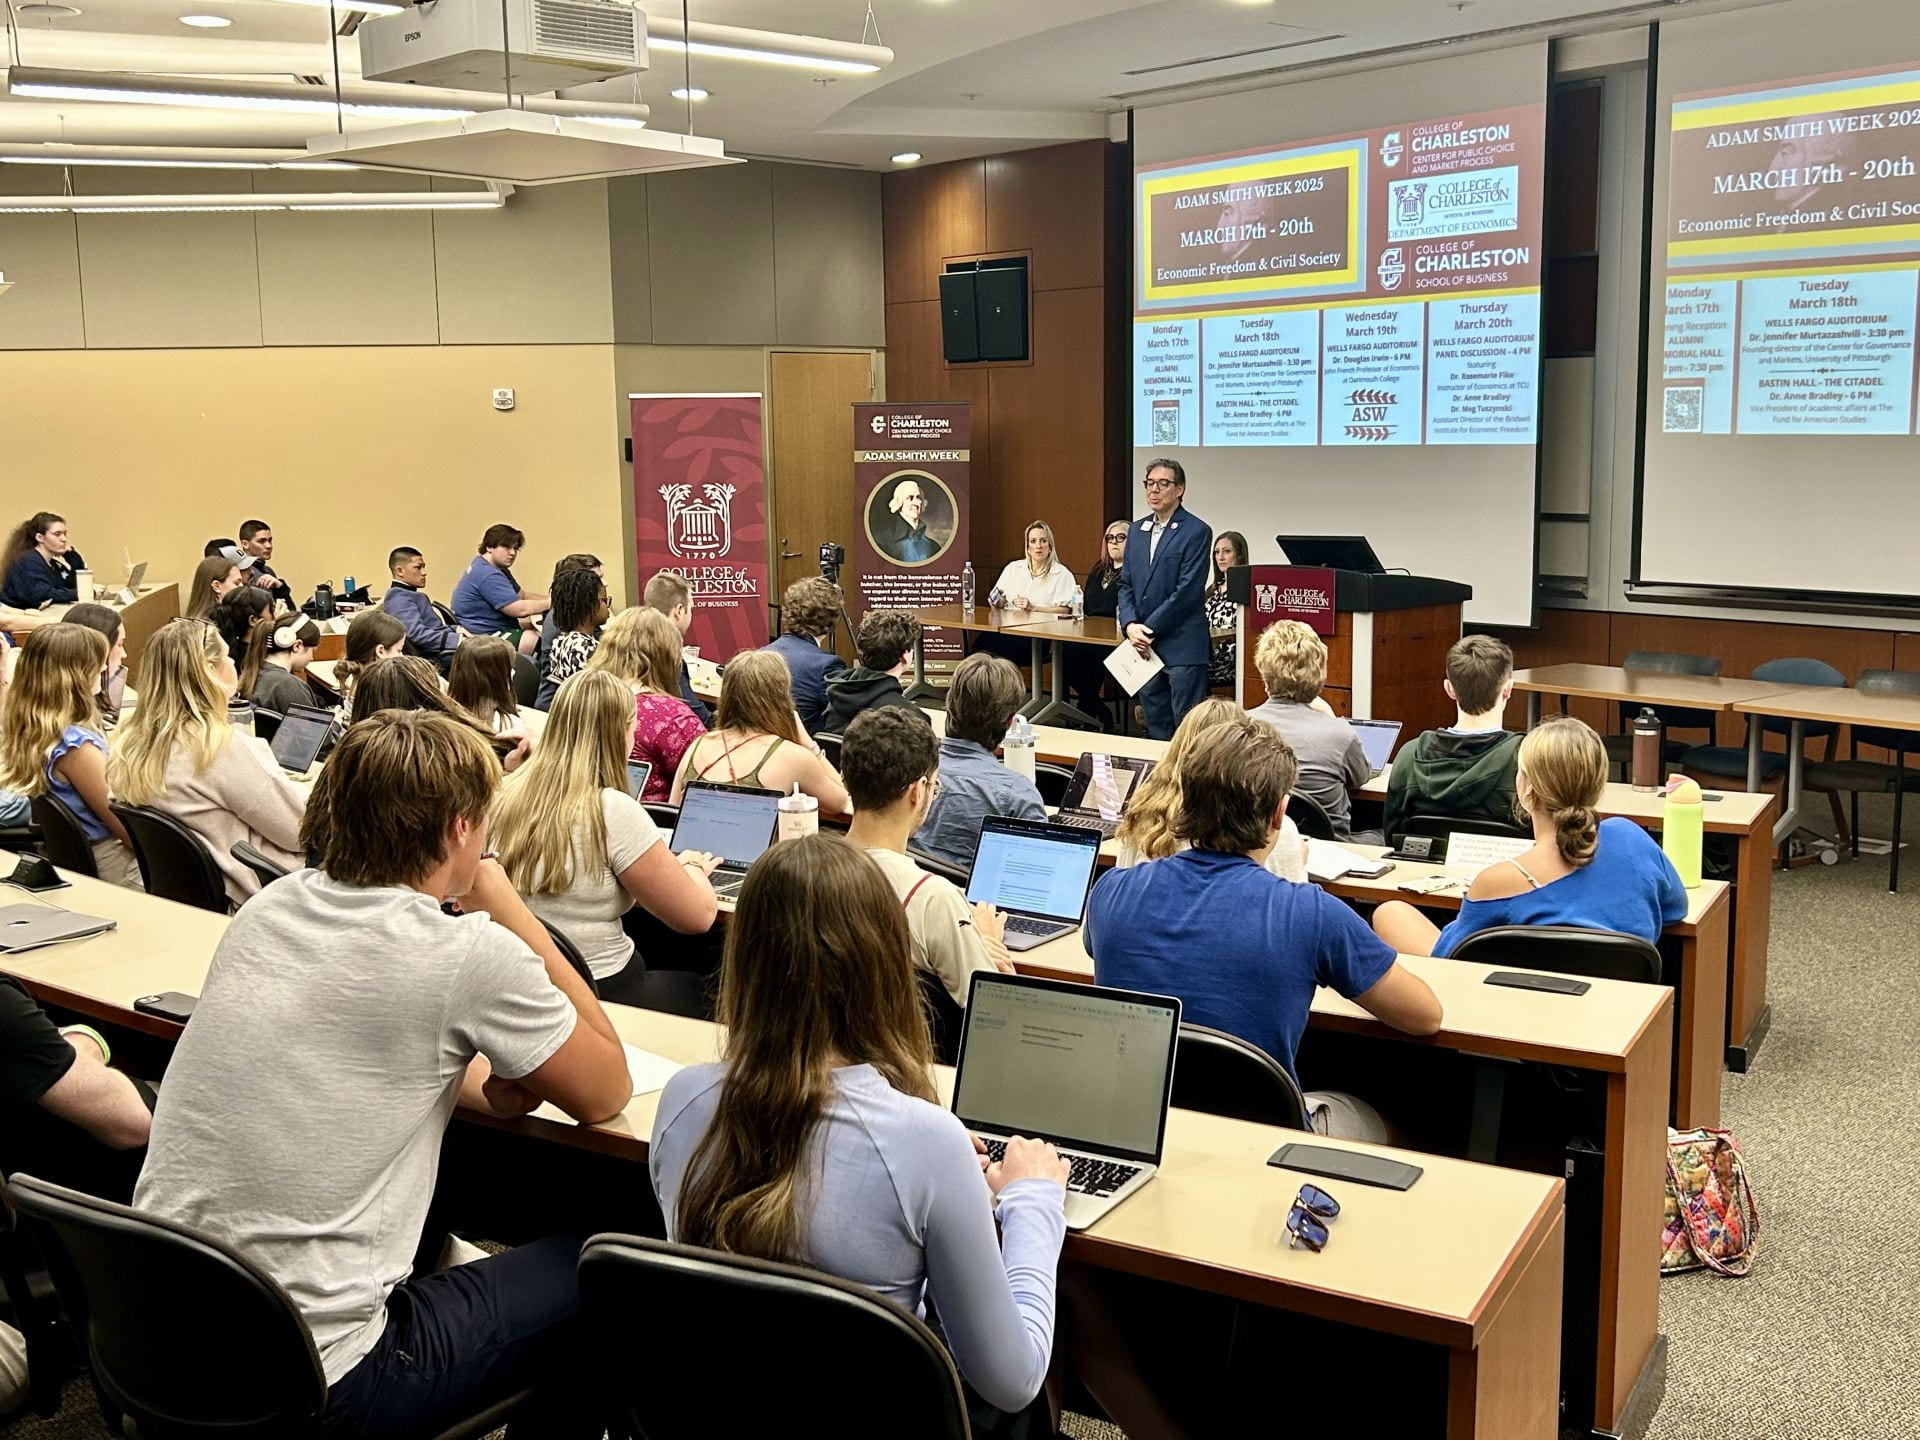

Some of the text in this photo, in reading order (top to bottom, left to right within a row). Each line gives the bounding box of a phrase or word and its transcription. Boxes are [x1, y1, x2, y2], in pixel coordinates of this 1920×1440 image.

[404, 31, 421, 42] EPSON
[1413, 121, 1463, 136] COLLEGE OF
[1706, 108, 1920, 149] ADAM SMITH WEEK 202
[1412, 124, 1509, 152] CHARLESTON
[1413, 143, 1515, 165] CENTER FOR PUBLIC CHOICE
[1412, 156, 1494, 174] AND MARKET PROCESS
[1713, 168, 1798, 195] MARCH
[1802, 163, 1843, 185] 17th
[1864, 156, 1915, 180] 20th
[1439, 178, 1503, 195] COLLEGE of
[1174, 177, 1324, 210] ADAM SMITH WEEK 2025
[1429, 188, 1509, 208] CHARLESTON
[1678, 200, 1920, 233] Economic Freedom & Civil Soc
[1180, 226, 1236, 248] MARCH
[1240, 223, 1266, 241] 17th
[1280, 217, 1313, 237] 20th
[1389, 218, 1517, 239] DEPARTMENT OF ECONOMICS
[1416, 240, 1475, 255] COLLEGE OF
[1158, 251, 1341, 280] Economic Freedom & Civil Society
[1415, 247, 1529, 273] CHARLESTON
[1416, 272, 1508, 288] SCHOOL OF BUSINESS
[1800, 280, 1849, 292] Tuesday
[1668, 287, 1711, 299] Monday
[1460, 302, 1508, 314] Thursday
[1696, 302, 1719, 313] 17th
[1789, 296, 1857, 309] March 18th
[1346, 310, 1398, 322] Wednesday
[1765, 315, 1887, 327] WELLS FARGO AUDITORIUM
[1240, 318, 1274, 329] Tuesday
[1455, 318, 1512, 330] March 20th
[1686, 322, 1726, 331] Reception
[1153, 325, 1183, 335] Monday
[1346, 326, 1396, 337] March 19th
[1763, 331, 1797, 342] Jennifer
[1868, 328, 1886, 337] 3:30
[1889, 330, 1904, 338] pm
[1148, 338, 1188, 348] March 17th
[1235, 332, 1280, 343] March 18th
[1433, 334, 1535, 346] WELLS FARGO AUDITORIUM
[1668, 336, 1704, 344] ALUMNI
[1260, 347, 1300, 355] AUDITORIUM
[1327, 341, 1417, 352] WELLS FARGO AUDITORIUM
[1142, 353, 1194, 363] Opening Reception
[1436, 350, 1458, 358] PANEL
[1461, 348, 1506, 357] DISCUSSION
[1664, 349, 1723, 358] MORIAL HALL
[1344, 355, 1370, 364] Douglas
[1467, 361, 1496, 369] featuring
[1709, 364, 1723, 372] pm
[1759, 379, 1790, 387] BASTIN
[1793, 379, 1816, 387] HALL
[1844, 378, 1883, 386] CITADEL
[1809, 392, 1843, 402] Bradley
[1858, 391, 1872, 399] PM
[1352, 407, 1388, 422] ASW
[891, 420, 949, 428] CHARLESTON
[864, 452, 893, 460] ADAM
[896, 452, 926, 460] SMITH
[736, 568, 747, 581] of
[692, 579, 756, 593] LESTON
[1284, 588, 1318, 597] COLLEGE
[1278, 595, 1329, 606] CHARLESTON
